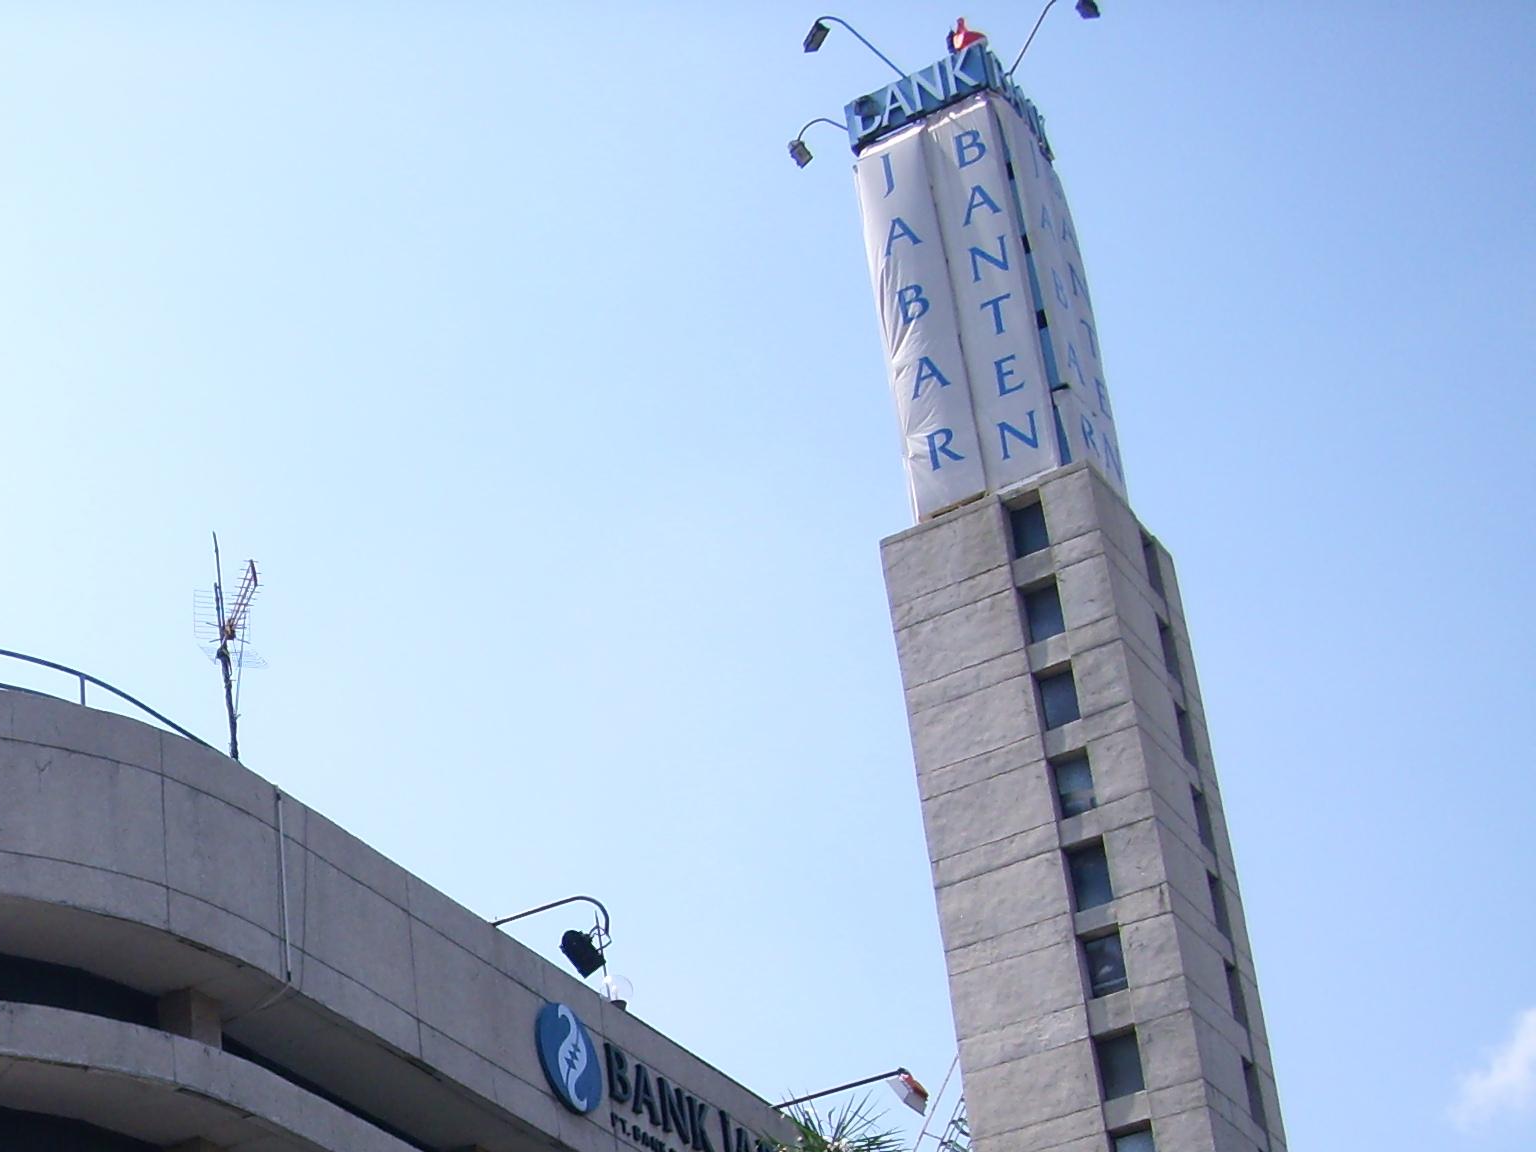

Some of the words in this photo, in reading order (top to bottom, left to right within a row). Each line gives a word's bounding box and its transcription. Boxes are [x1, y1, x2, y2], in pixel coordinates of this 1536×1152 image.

[880, 152, 965, 471] JABAR
[954, 129, 1041, 461] BANTEN
[610, 1112, 632, 1136] PT.
